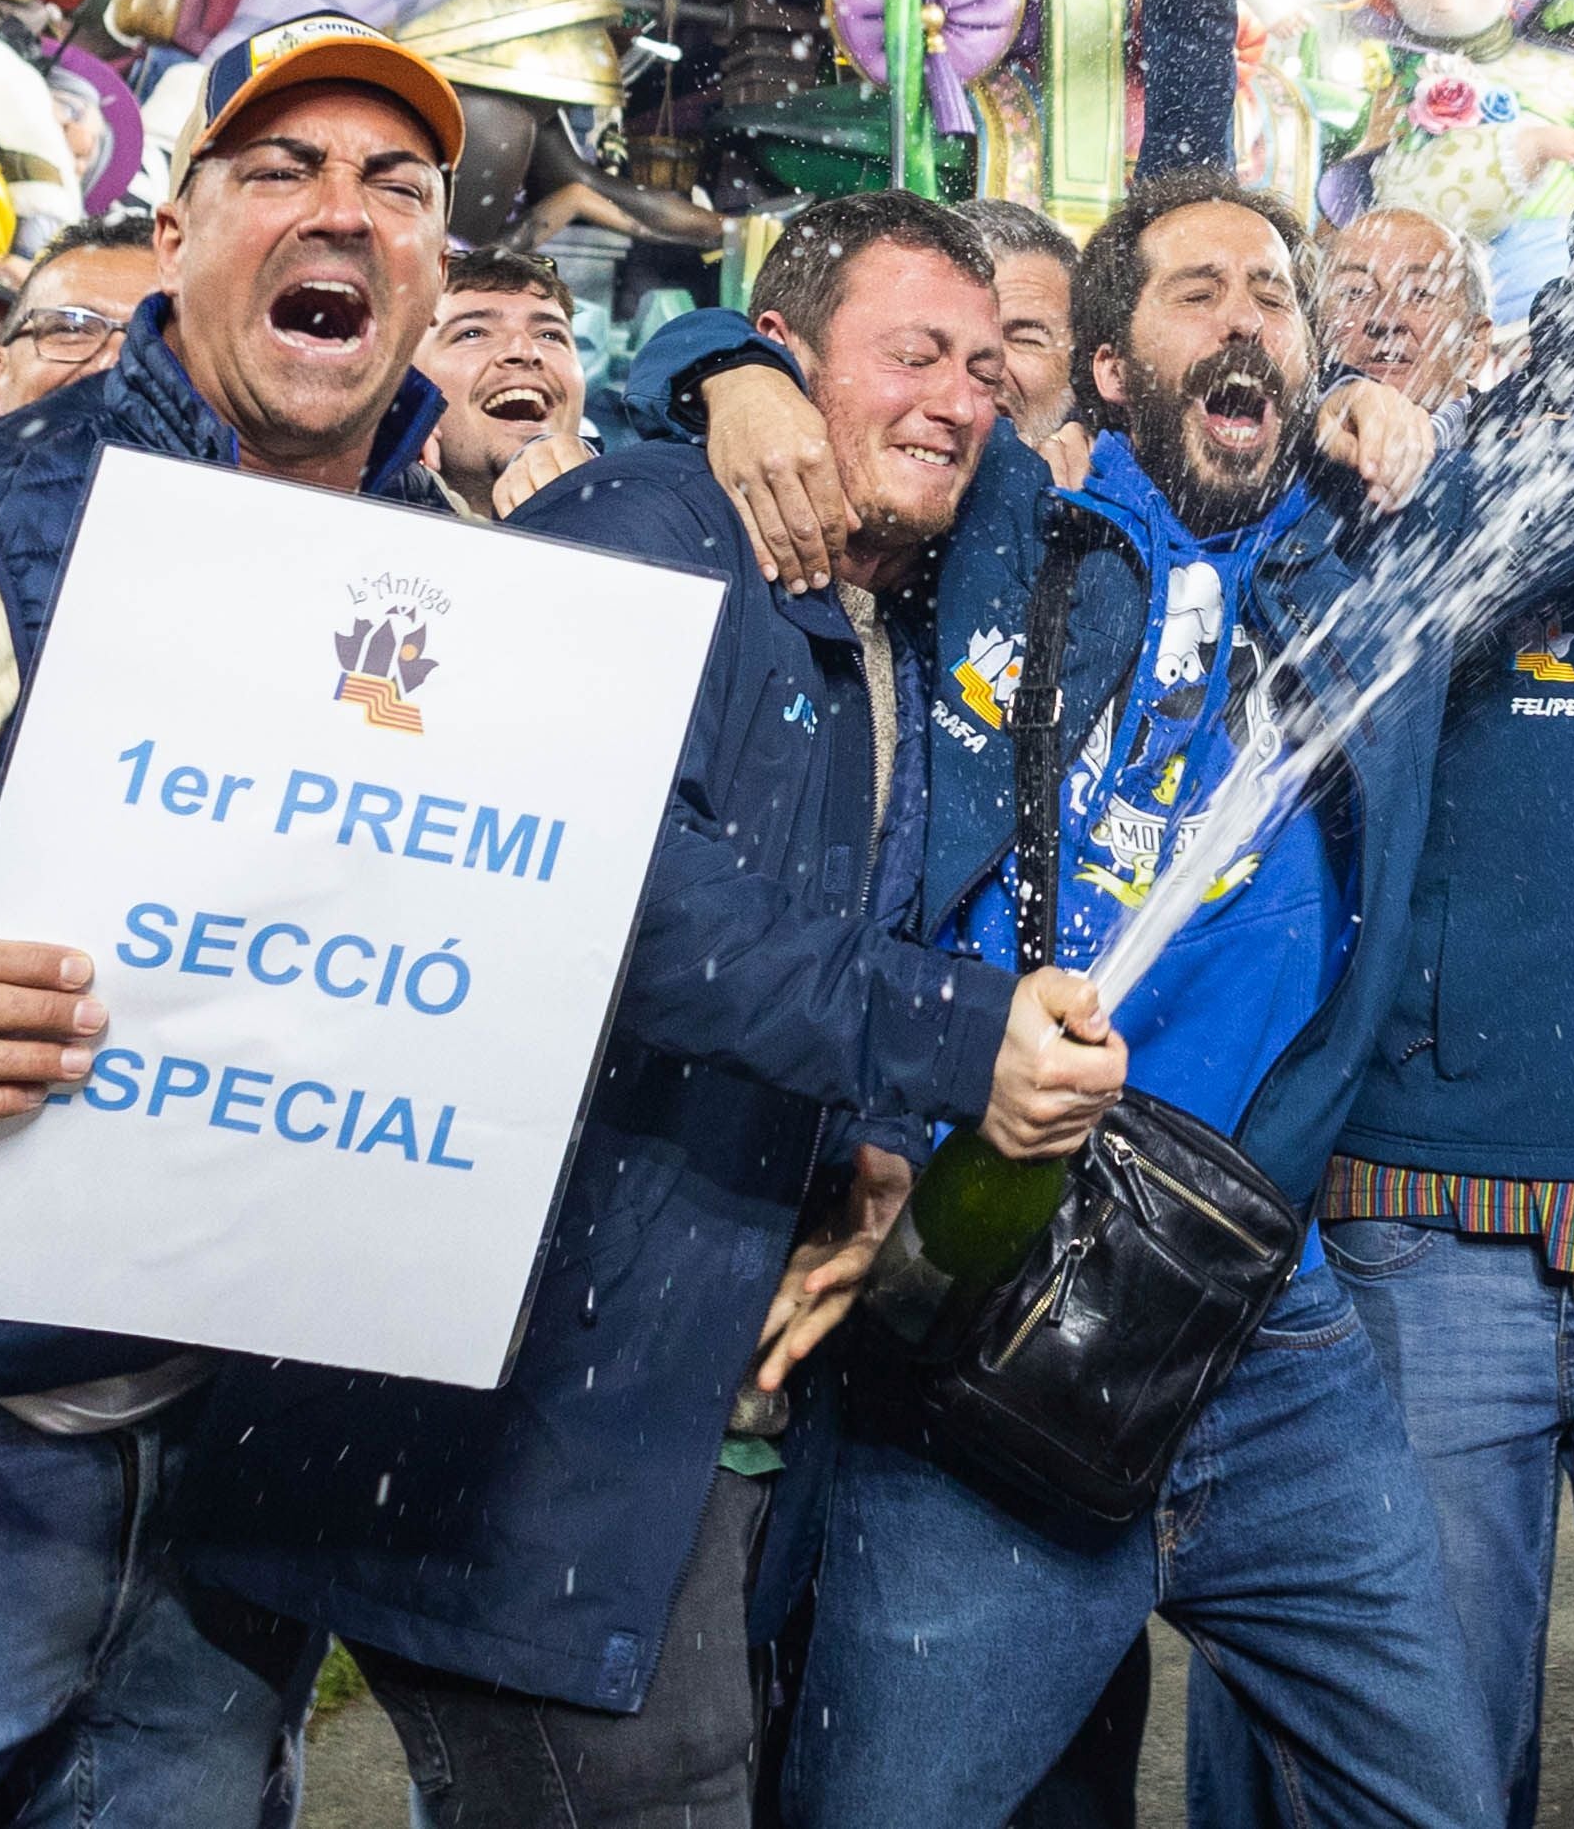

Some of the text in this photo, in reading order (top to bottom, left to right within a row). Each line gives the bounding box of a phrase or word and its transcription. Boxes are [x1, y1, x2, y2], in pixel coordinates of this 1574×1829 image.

[347, 571, 451, 615] L'Antiga
[931, 700, 988, 754] RAFA
[117, 738, 567, 883] 1er PREMI
[115, 901, 471, 1016] SECCIÓ
[46, 1047, 475, 1171] SPECIAL
